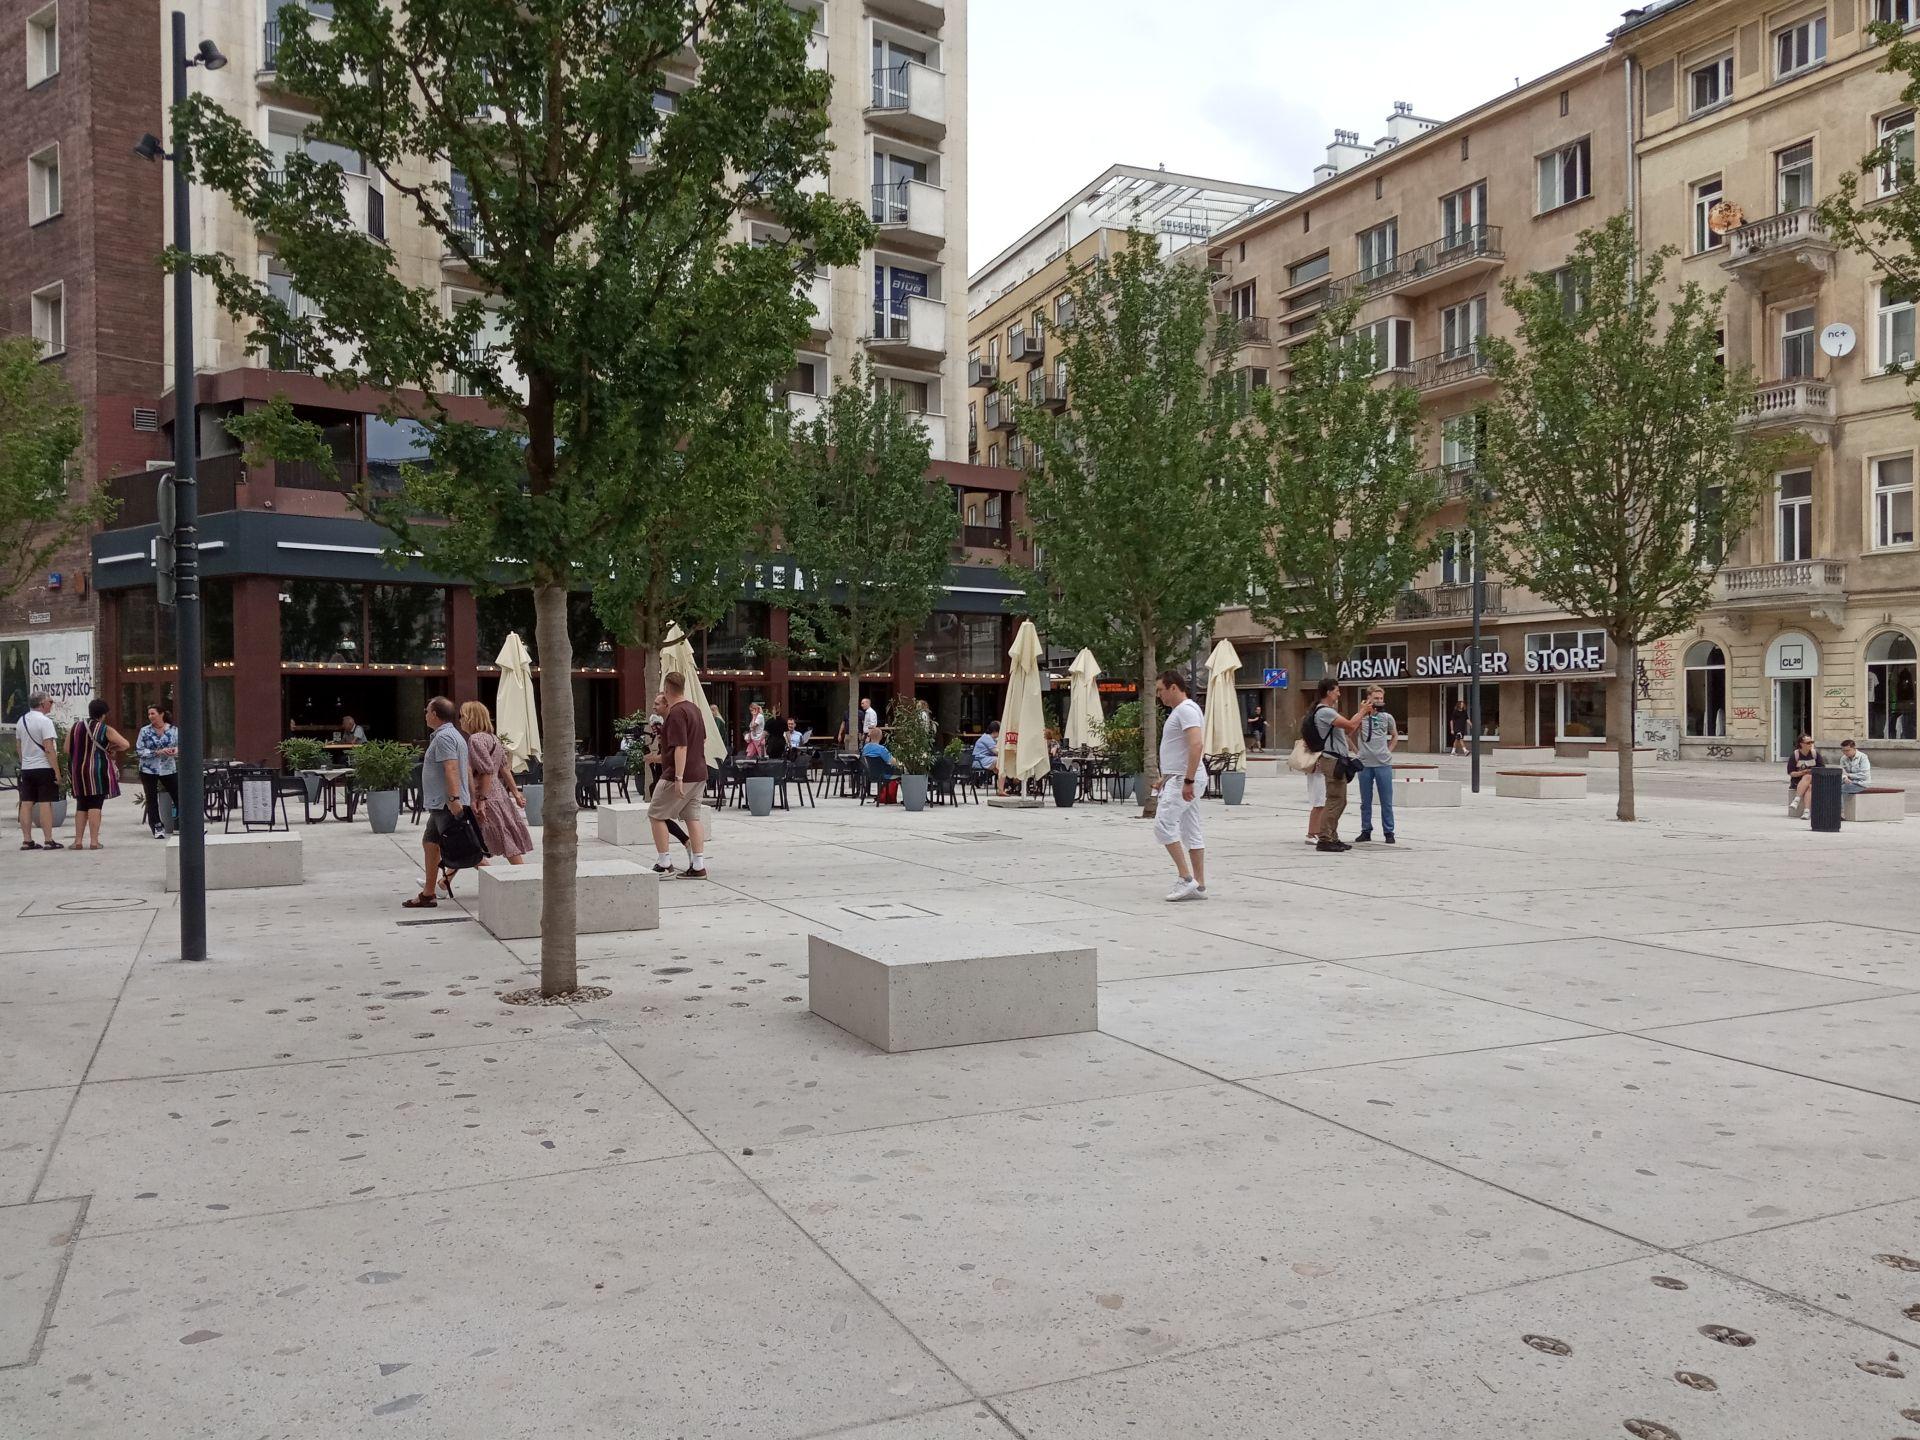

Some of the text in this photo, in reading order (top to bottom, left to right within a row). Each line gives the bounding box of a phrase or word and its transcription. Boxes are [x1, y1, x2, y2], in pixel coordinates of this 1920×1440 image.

[76, 652, 90, 664] Jerzy
[1325, 647, 1600, 678] ARSAW SNEAER STORE
[32, 659, 50, 676] Gra
[64, 664, 91, 678] Krawczyk
[41, 676, 91, 702] wszystko
